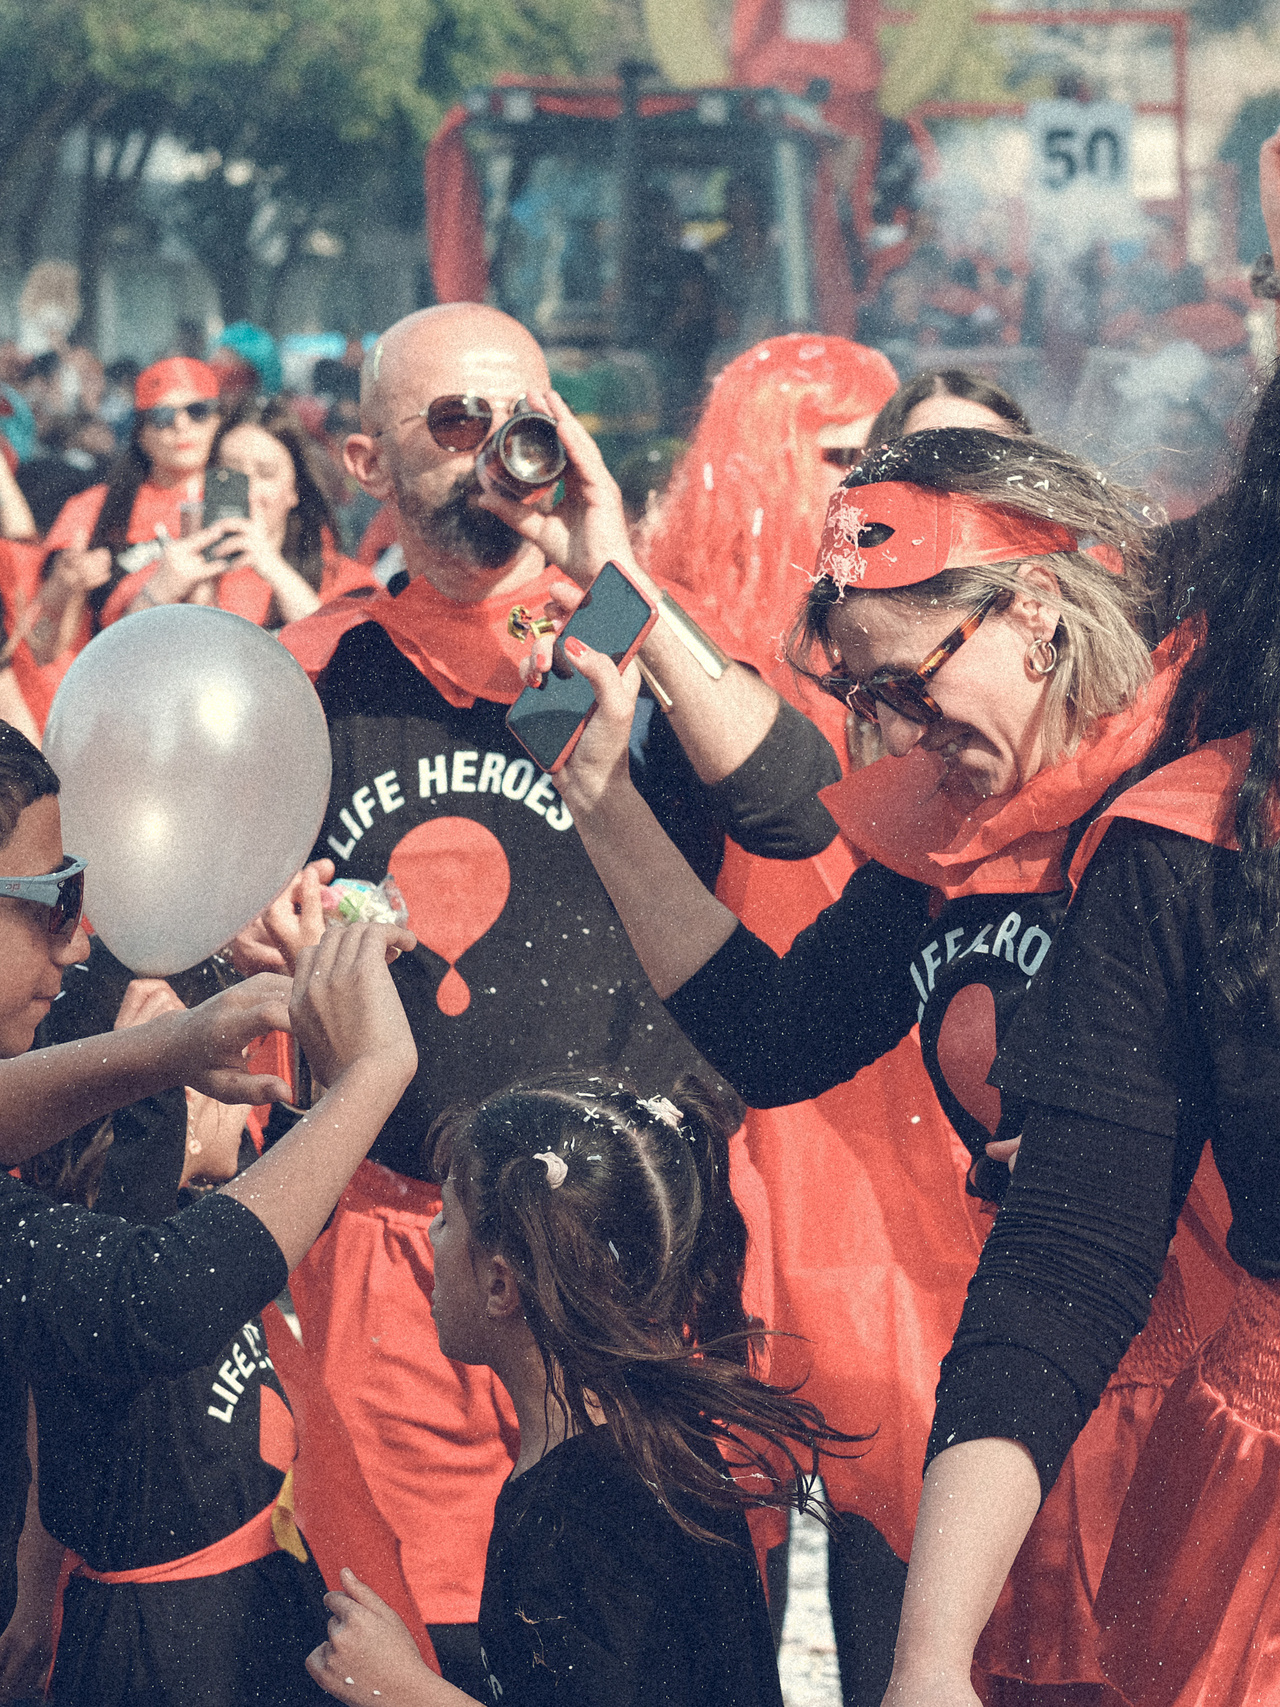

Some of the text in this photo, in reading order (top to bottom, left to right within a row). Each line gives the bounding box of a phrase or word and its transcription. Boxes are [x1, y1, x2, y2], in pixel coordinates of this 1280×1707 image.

[1045, 127, 1121, 190] 50
[327, 750, 575, 862] LIFE HEROES
[207, 1342, 257, 1424] LIFE
